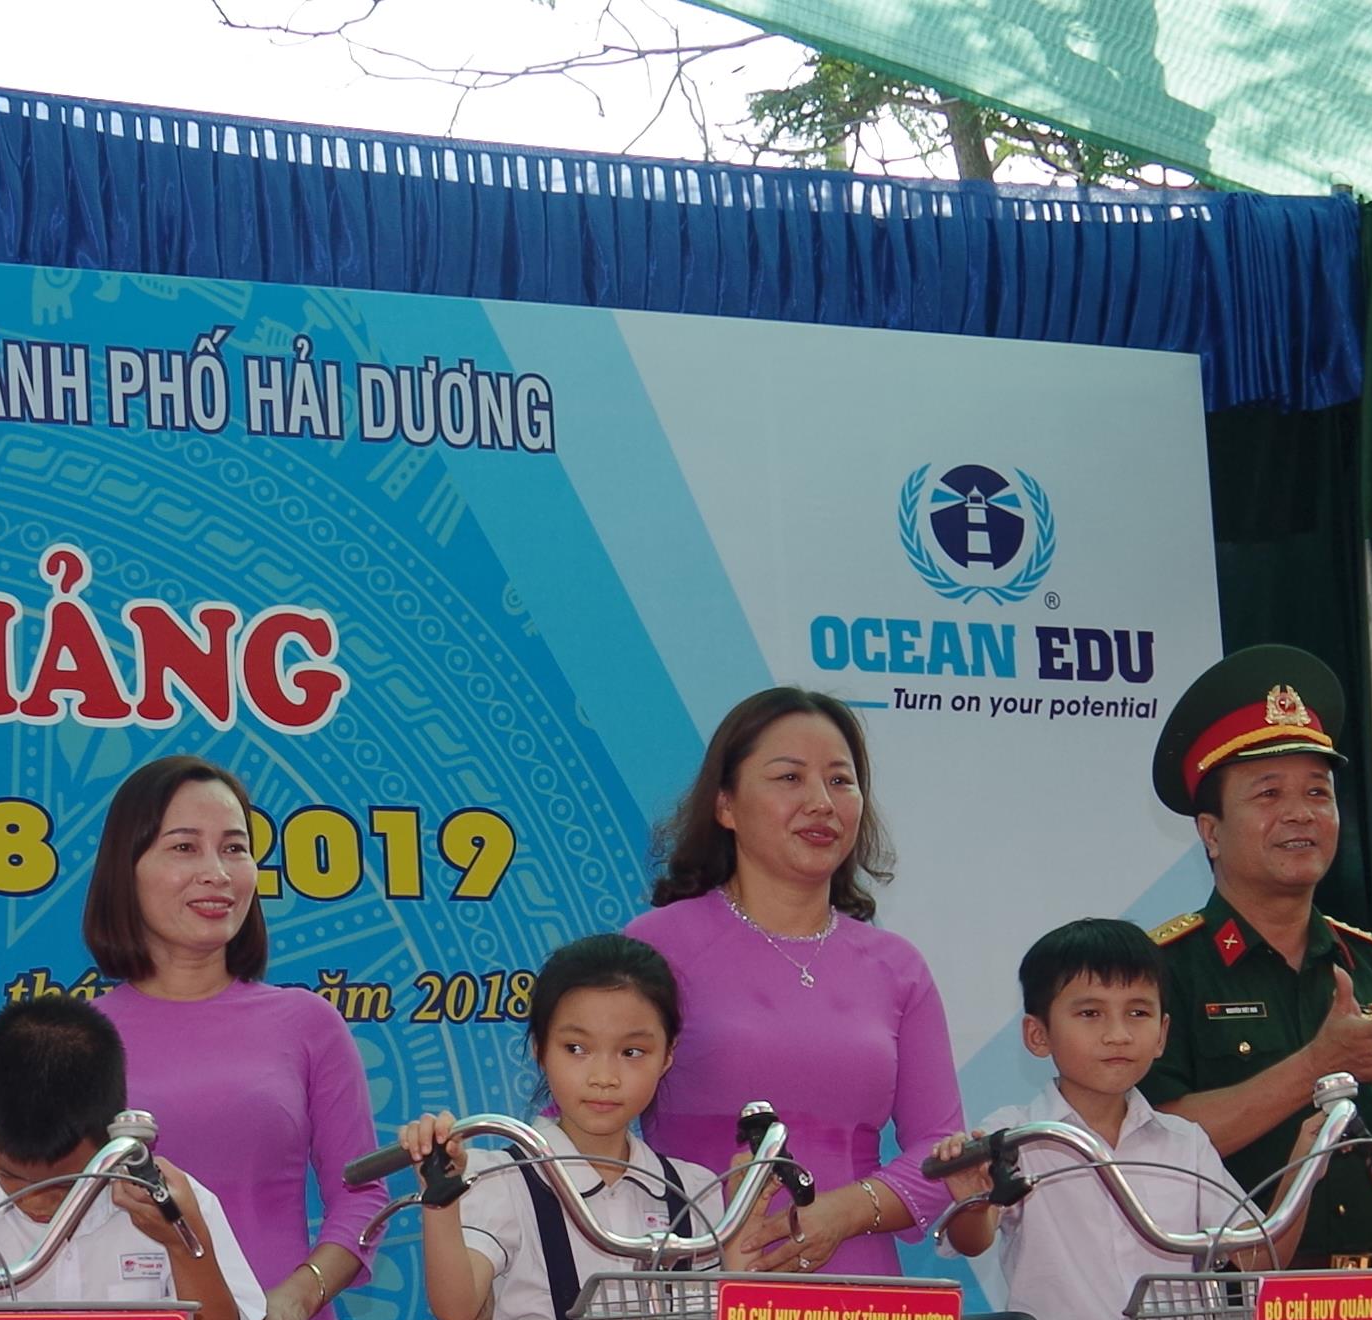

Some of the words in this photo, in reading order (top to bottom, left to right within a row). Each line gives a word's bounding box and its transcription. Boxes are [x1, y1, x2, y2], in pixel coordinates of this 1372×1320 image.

[110, 328, 232, 430] PHỐ
[247, 337, 341, 437] HẢI
[361, 357, 553, 450] DƯƠNG
[810, 615, 1017, 679] OCEAN
[1035, 625, 1155, 684] EDU
[893, 687, 940, 711] Turn
[950, 696, 981, 713] on
[989, 697, 1043, 718] your
[1049, 696, 1158, 720] potential
[305, 970, 394, 1021] ăm
[414, 972, 535, 1022] 2018
[1310, 1298, 1337, 1320] HUY
